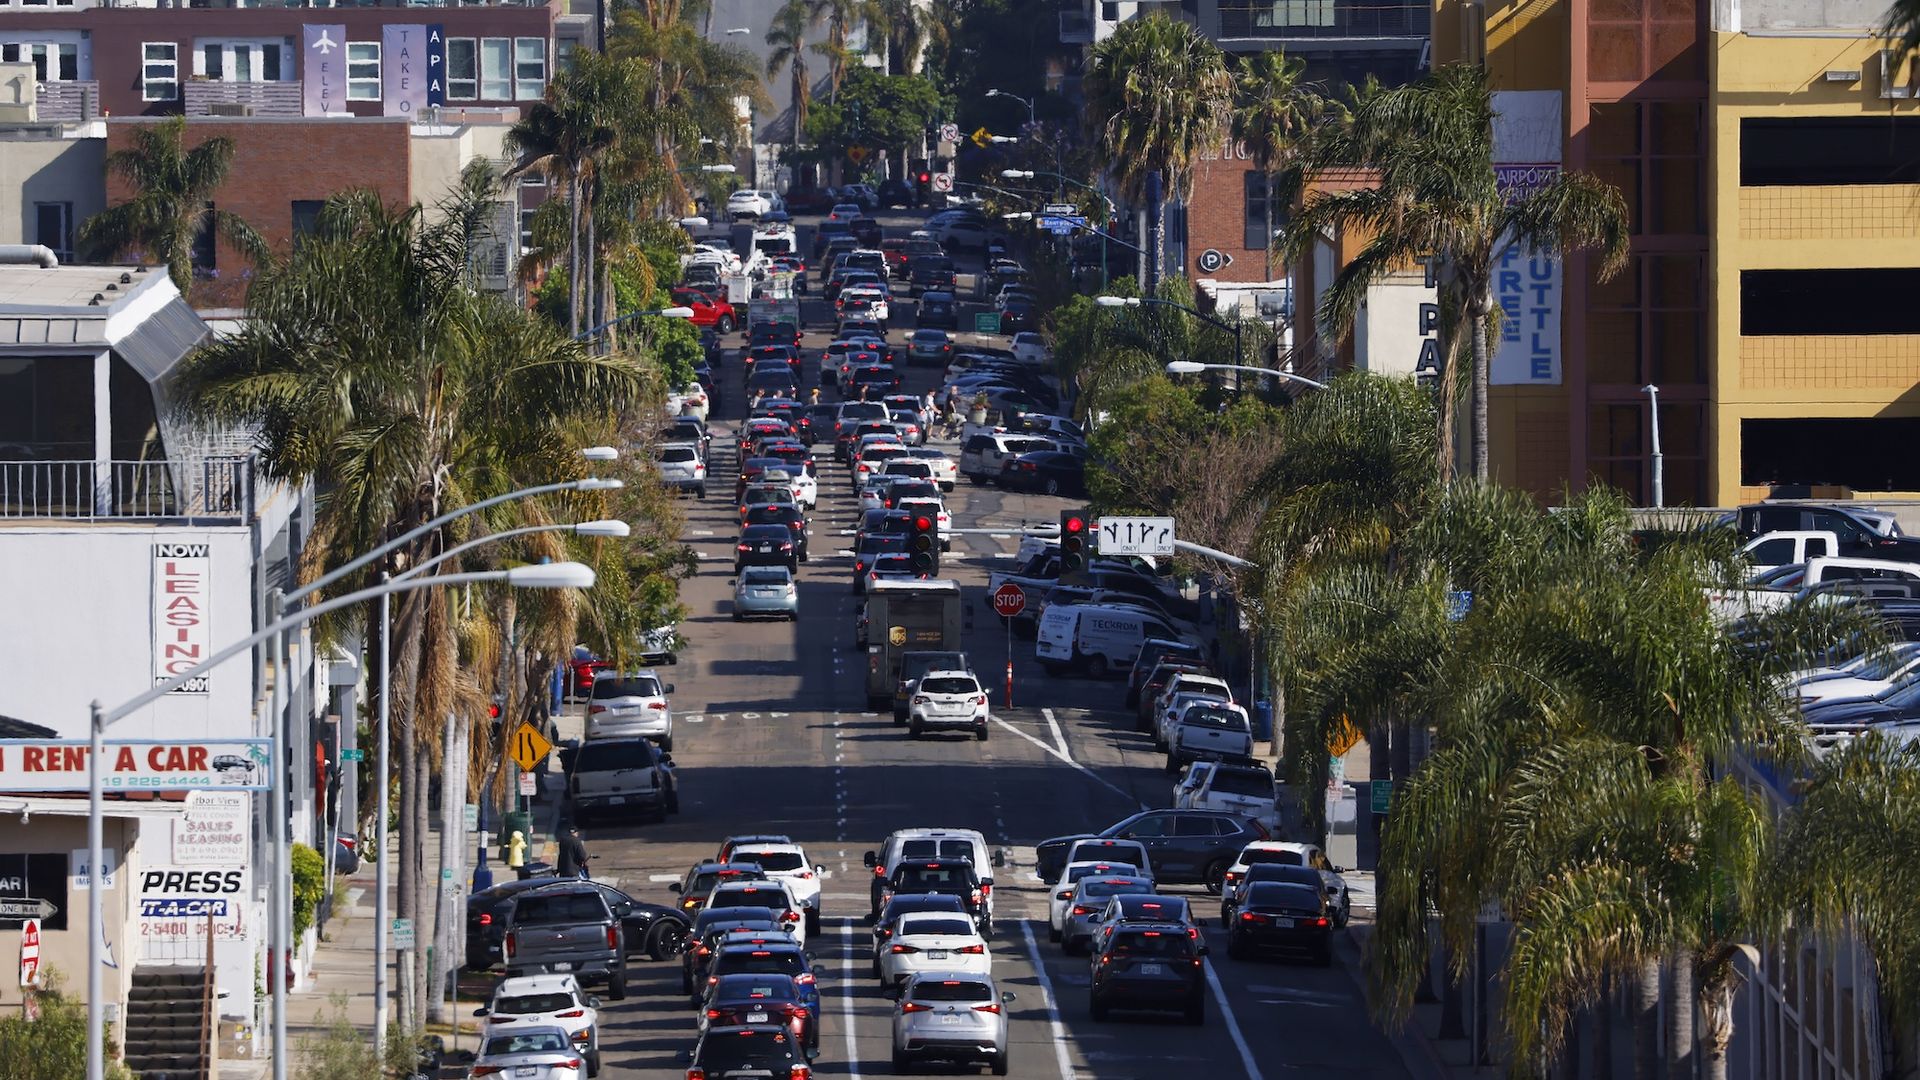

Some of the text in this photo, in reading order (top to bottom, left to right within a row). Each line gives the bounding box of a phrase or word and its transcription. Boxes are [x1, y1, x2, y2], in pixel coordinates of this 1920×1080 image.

[400, 30, 410, 90] TAKE
[430, 30, 440, 108] APA
[1496, 169, 1556, 184] AIRPORT
[1500, 246, 1524, 342] FREE
[1529, 255, 1553, 379] UTTLE
[157, 544, 207, 557] NOW
[996, 594, 1023, 607] STOP
[165, 562, 200, 675] LEASING
[23, 746, 208, 772] REN A CAR
[102, 777, 122, 786] 19
[186, 820, 233, 833] SALES
[177, 833, 243, 845] LEASING
[79, 864, 108, 875] AUO
[140, 871, 242, 893] PRESS
[1, 904, 39, 913] ONE WAY
